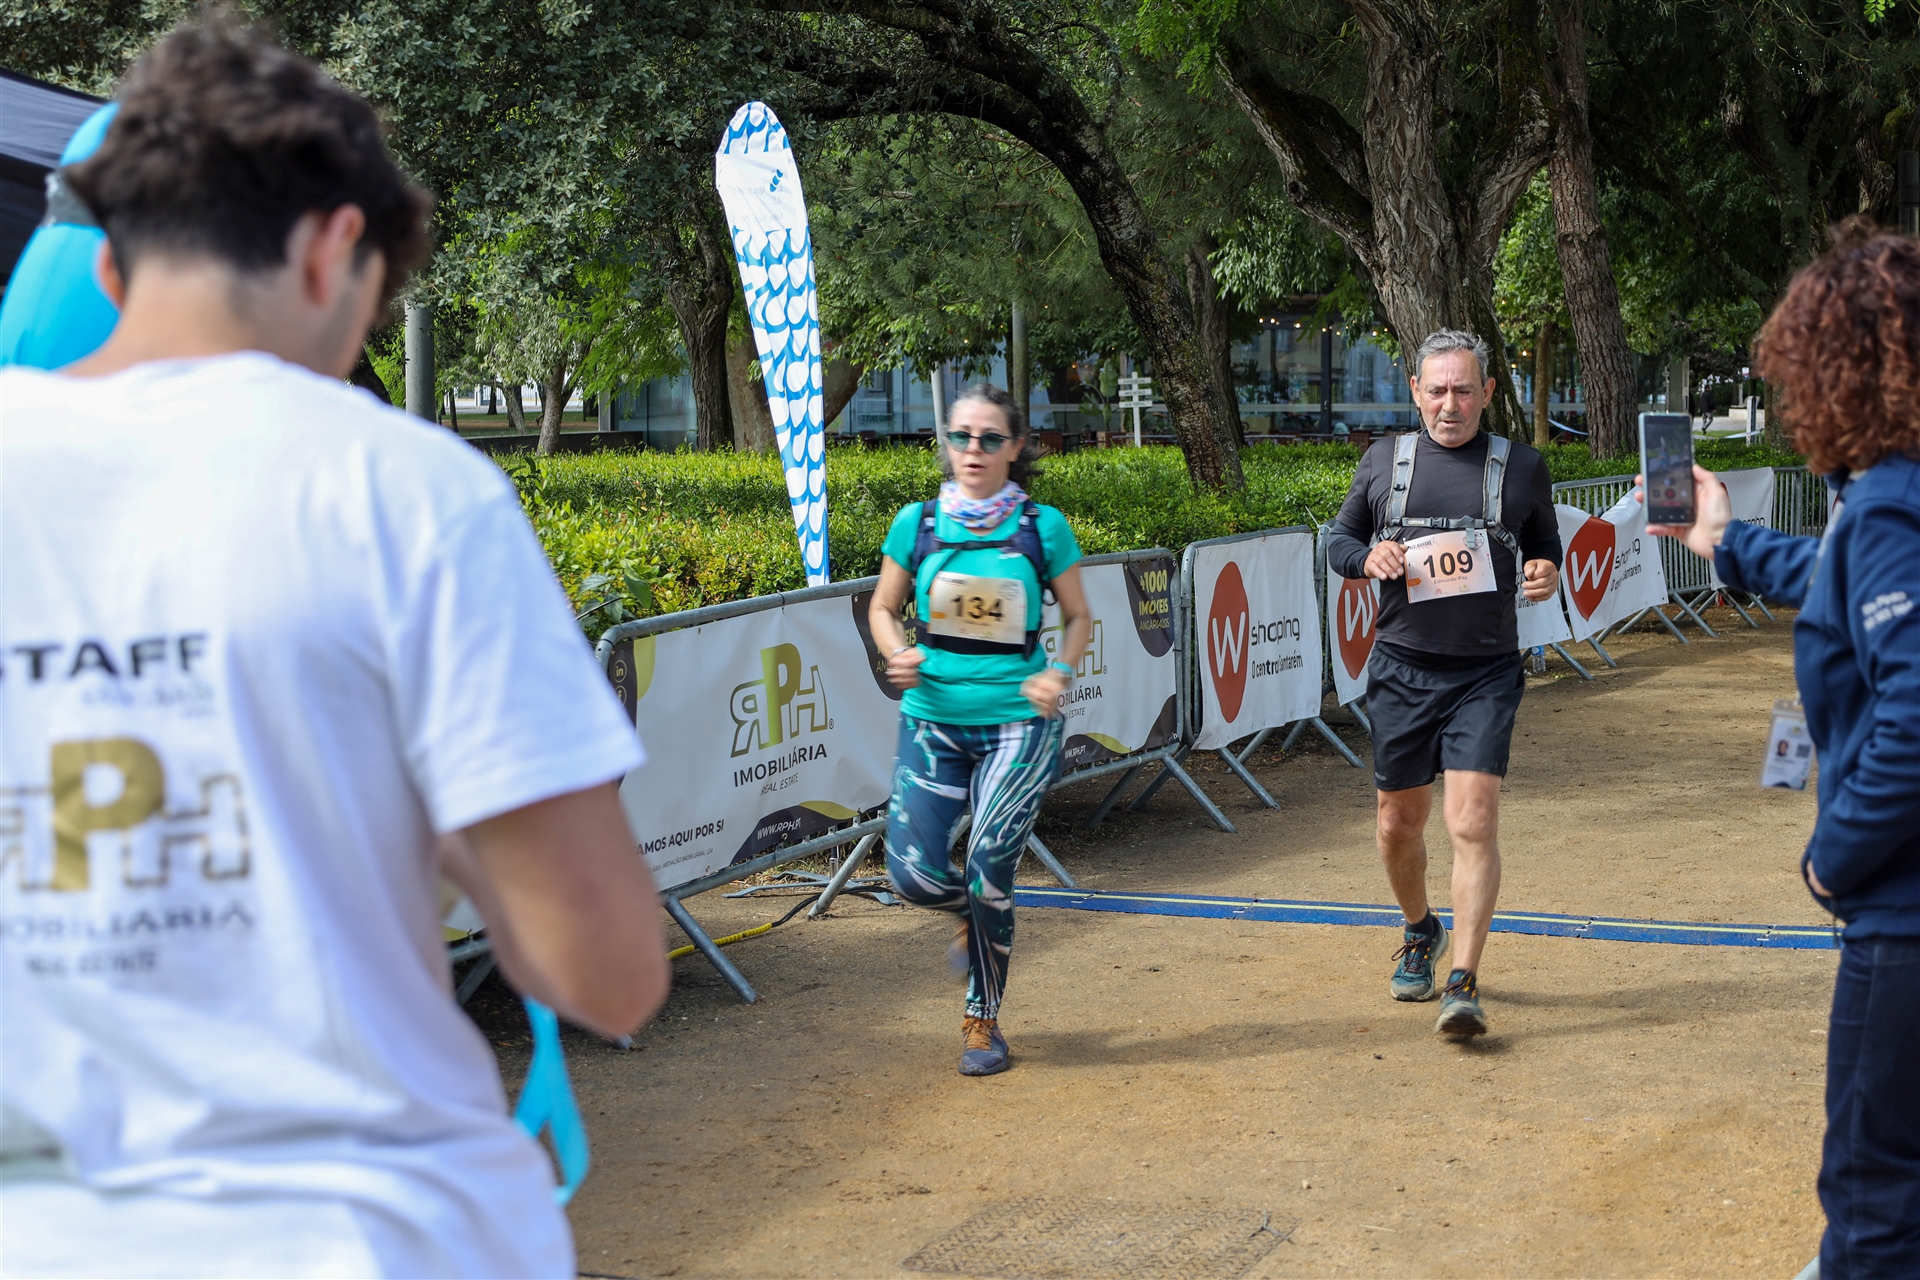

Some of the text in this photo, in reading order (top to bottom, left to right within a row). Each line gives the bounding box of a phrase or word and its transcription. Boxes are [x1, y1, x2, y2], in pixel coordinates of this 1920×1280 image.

[1423, 550, 1474, 578] 109
[1434, 577, 1457, 585] Edmundo
[951, 594, 1004, 622] 134
[0, 633, 206, 682] TAFF
[1058, 684, 1103, 708] OBILIÁRIA
[734, 743, 828, 787] IMOBILIÁRIA
[760, 773, 799, 796] REAL ESTATE
[636, 818, 725, 856] AMOS AQUI POR SI
